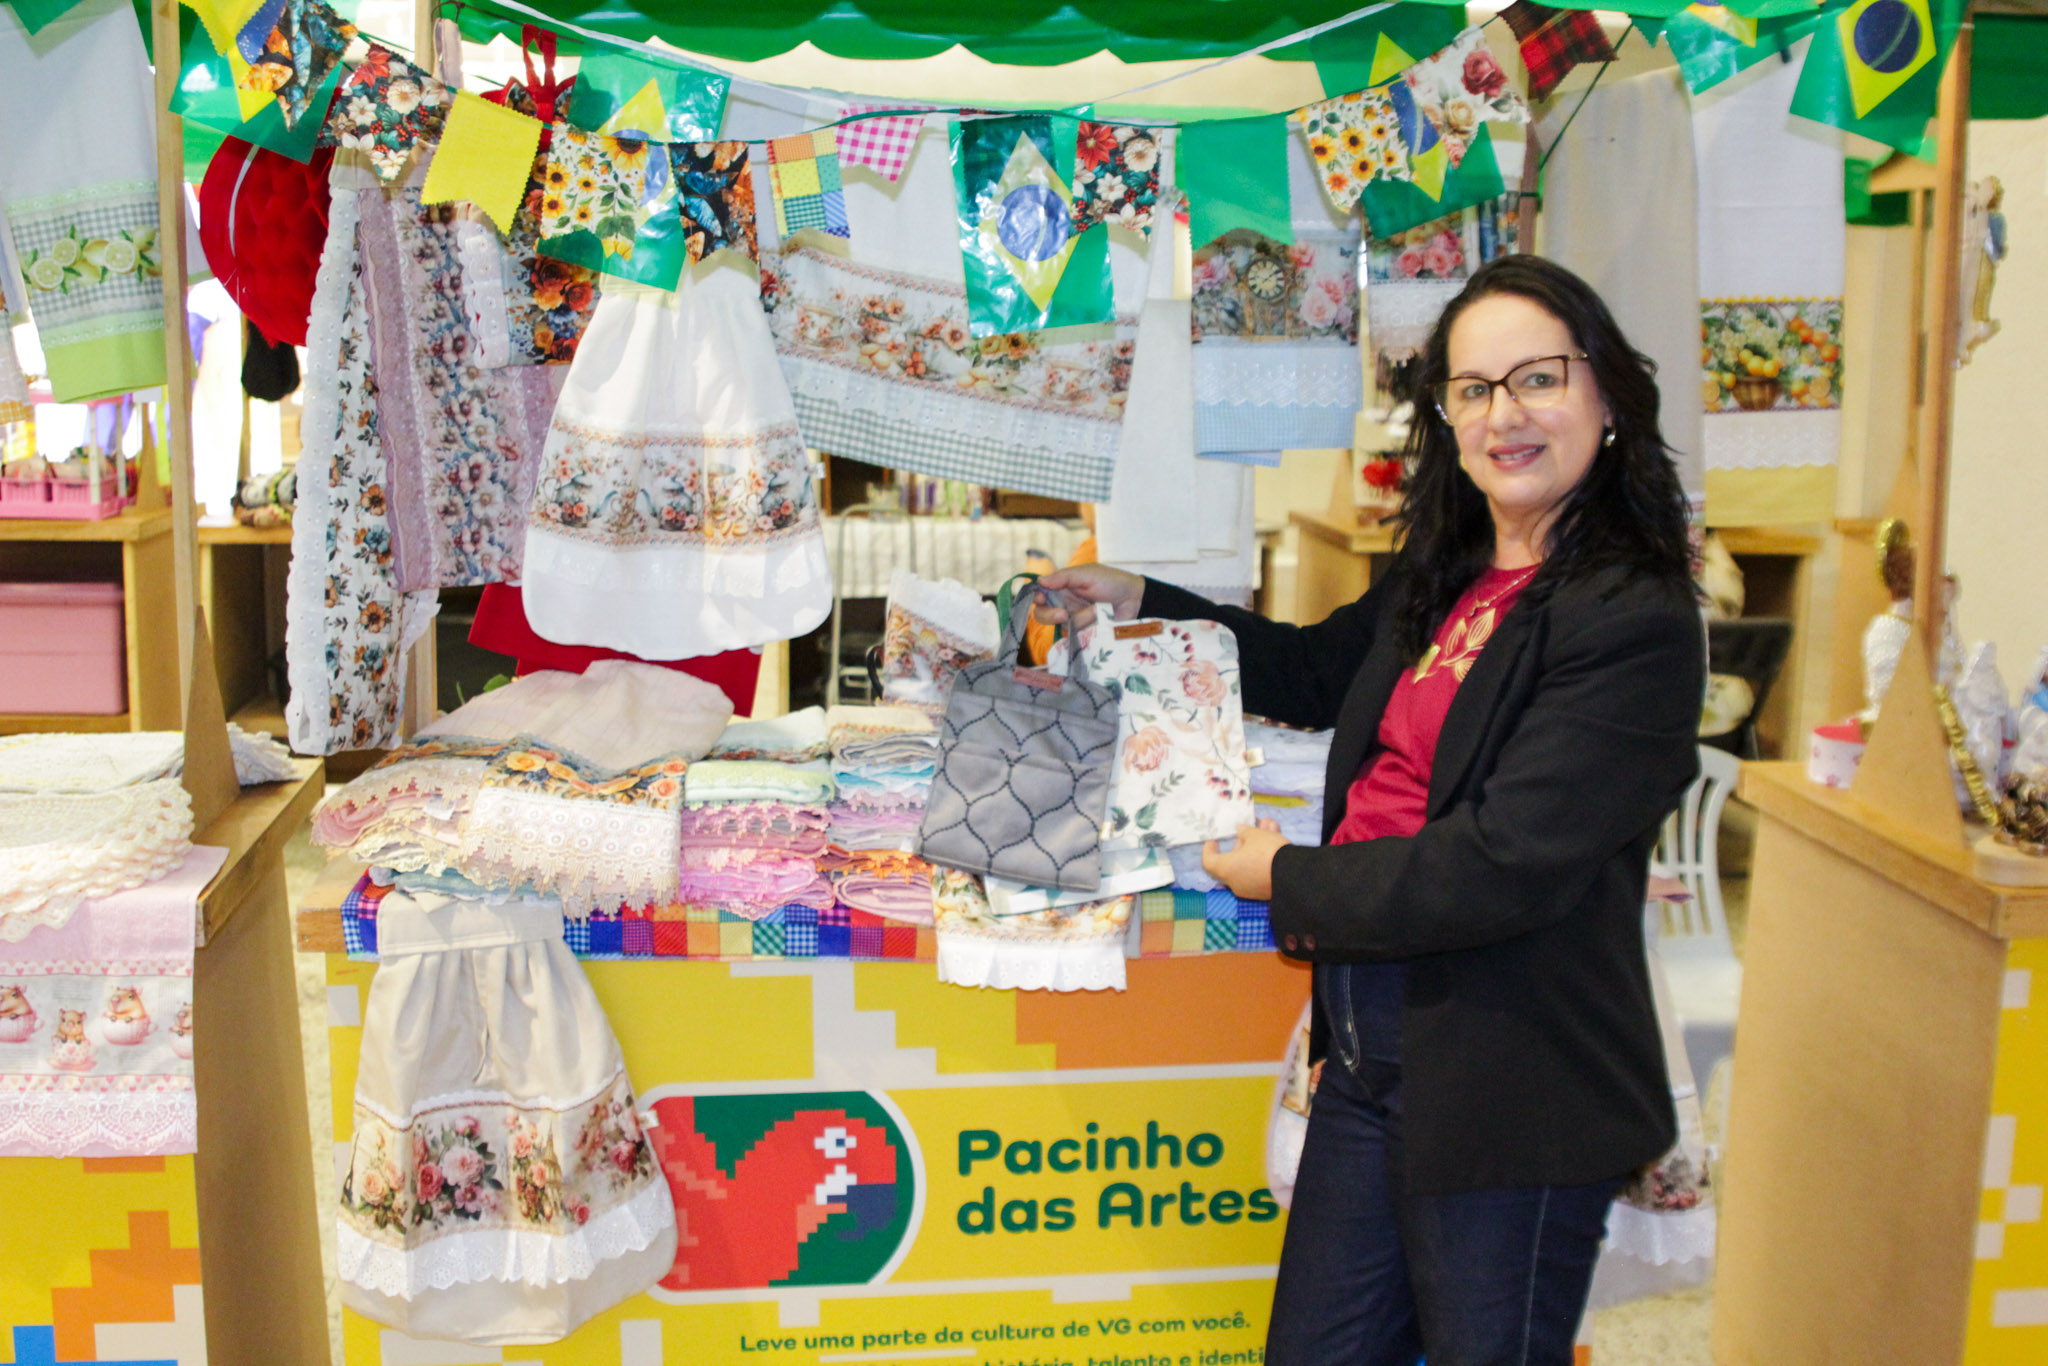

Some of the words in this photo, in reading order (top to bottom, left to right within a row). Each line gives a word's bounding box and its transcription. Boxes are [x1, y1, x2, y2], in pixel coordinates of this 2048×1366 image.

[957, 1119, 1225, 1178] Pacinho
[956, 1185, 1076, 1235] das
[1098, 1181, 1280, 1230] Artes
[740, 1335, 797, 1353] Leve
[804, 1335, 855, 1350] uma
[862, 1329, 927, 1351] parte
[934, 1326, 964, 1344] da
[970, 1324, 1055, 1342] cultura
[1062, 1320, 1090, 1338] de
[1097, 1318, 1132, 1335] VG
[1138, 1319, 1186, 1334] com
[1192, 1311, 1251, 1331] você.
